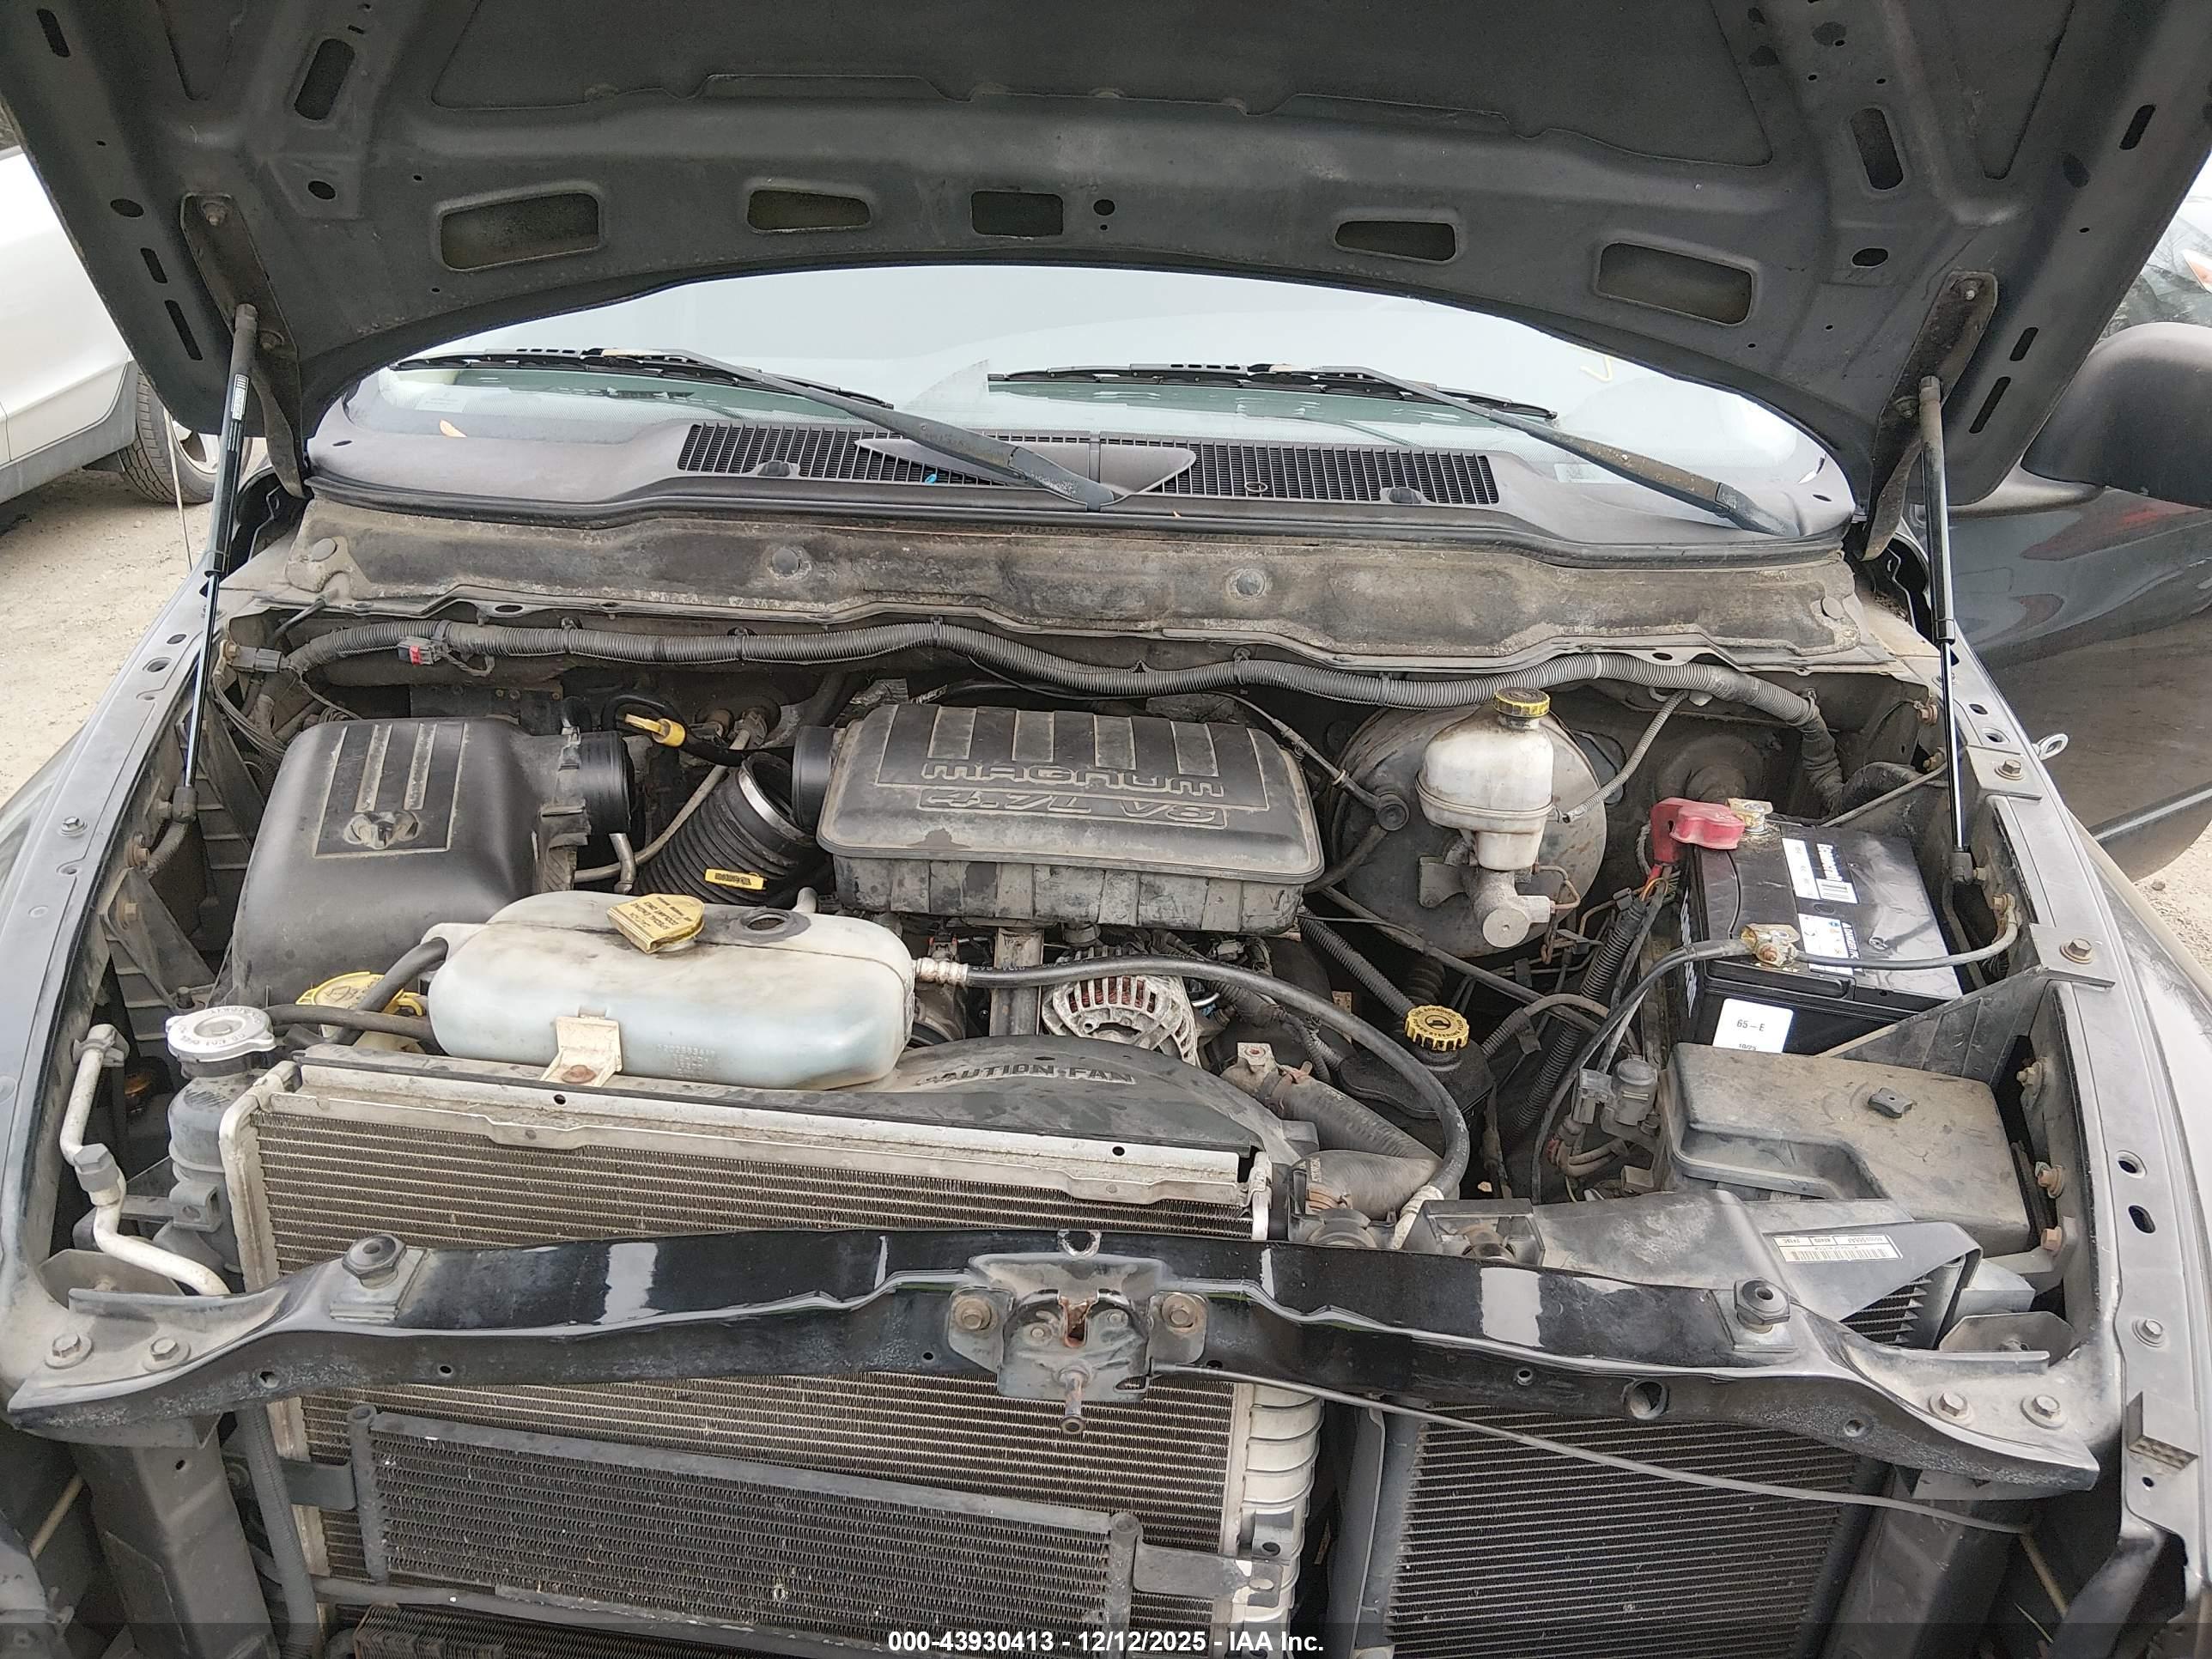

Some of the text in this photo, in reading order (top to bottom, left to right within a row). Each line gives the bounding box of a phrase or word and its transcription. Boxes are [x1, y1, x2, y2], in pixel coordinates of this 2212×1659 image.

[921, 763, 1224, 798] MAGNUM
[925, 788, 1217, 823] 4.7L V8
[1069, 1066, 1135, 1084] FAN
